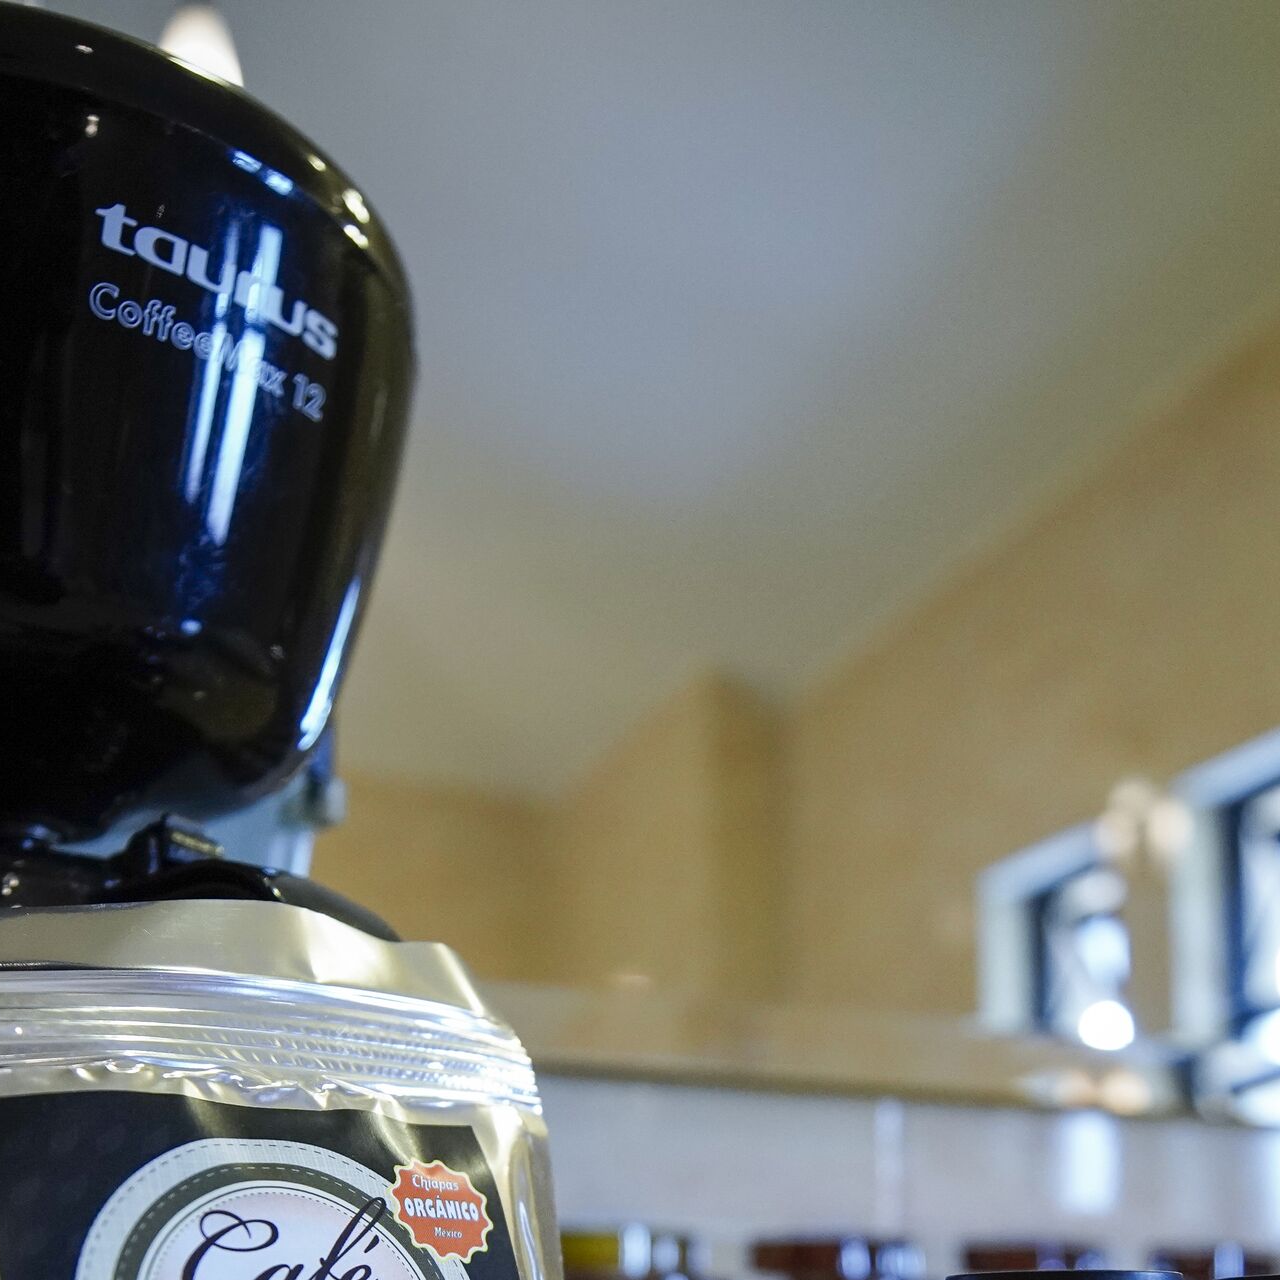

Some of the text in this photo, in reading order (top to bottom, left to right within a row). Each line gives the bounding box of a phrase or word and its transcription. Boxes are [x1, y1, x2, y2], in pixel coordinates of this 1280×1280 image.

[95, 203, 339, 360] taurus
[292, 373, 327, 423] 12
[411, 1174, 460, 1192] Chiapas
[404, 1195, 479, 1221] ORGÁNICO
